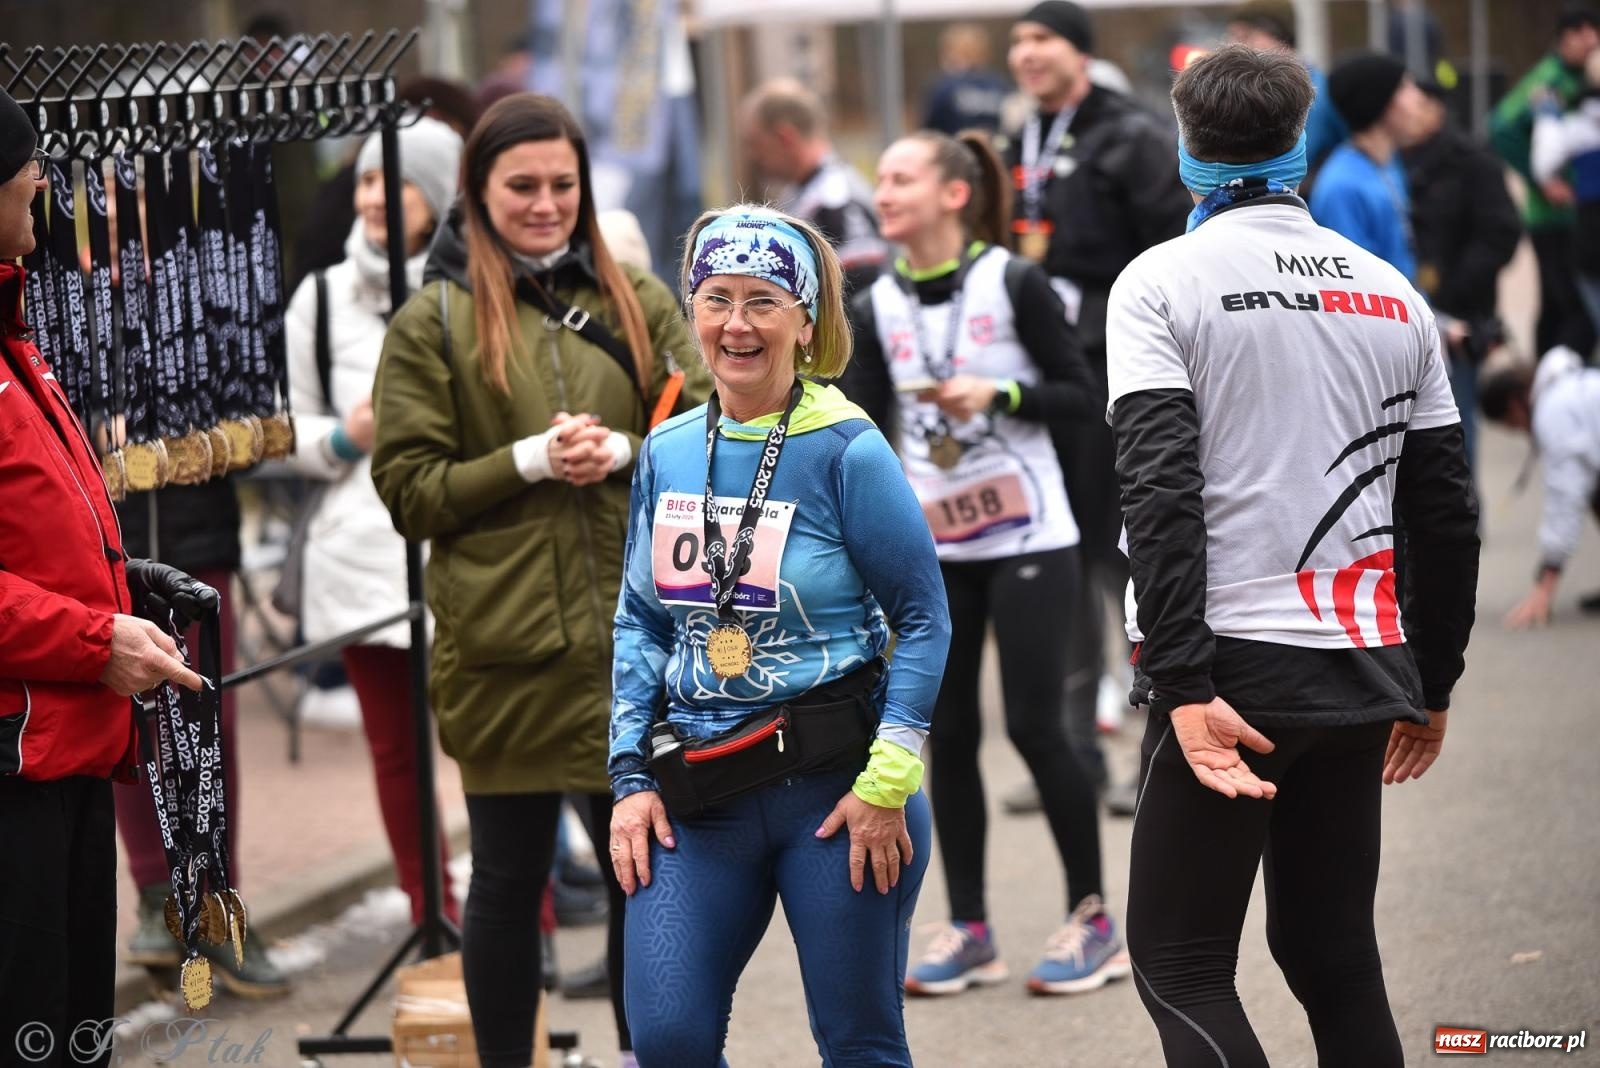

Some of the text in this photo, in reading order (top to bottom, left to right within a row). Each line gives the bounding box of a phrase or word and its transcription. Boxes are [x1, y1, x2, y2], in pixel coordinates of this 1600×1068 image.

[1274, 250, 1354, 280] MIKE
[31, 271, 51, 357] TWARDZIELA
[66, 270, 82, 353] 23.02.2025
[666, 498, 696, 512] BIEG
[749, 424, 786, 509] 23.02.2025
[939, 488, 1003, 527] 158
[166, 685, 194, 772] 23.02.2025
[147, 761, 174, 849] 23.02.2025
[165, 778, 178, 812] BIEG
[196, 747, 213, 834] 23.02.2025
